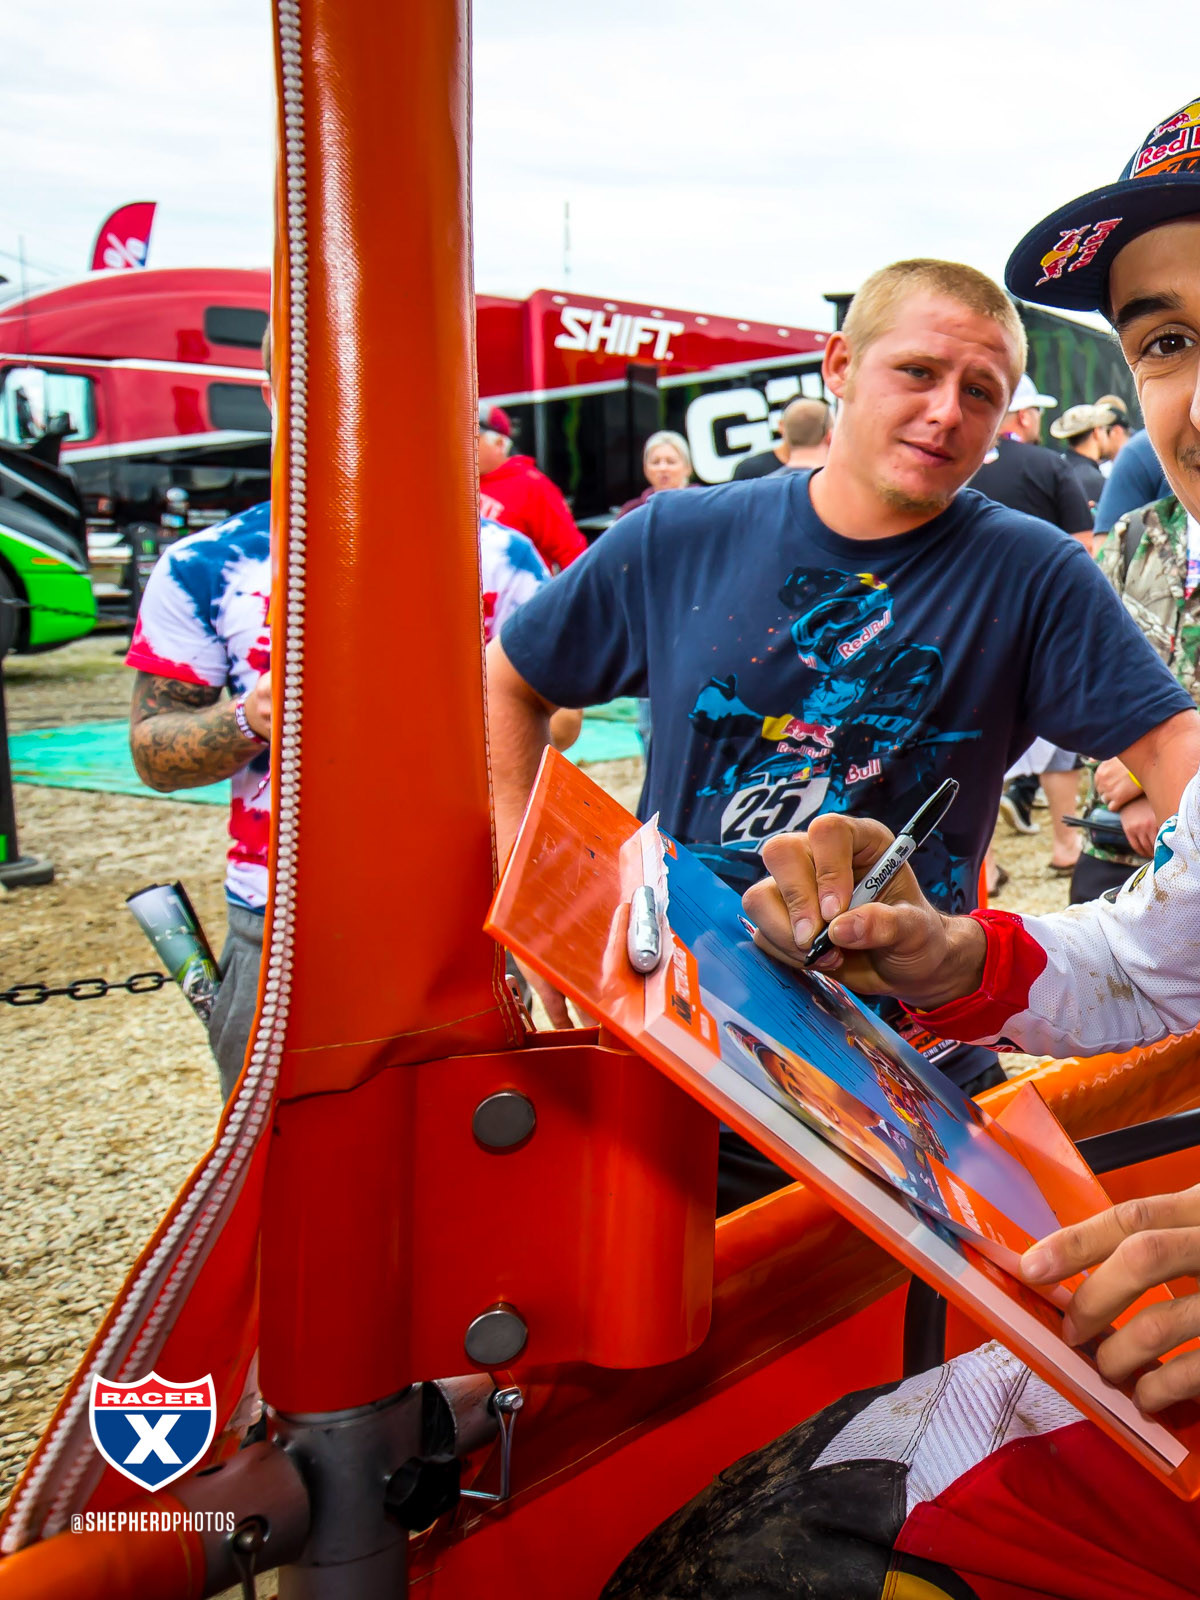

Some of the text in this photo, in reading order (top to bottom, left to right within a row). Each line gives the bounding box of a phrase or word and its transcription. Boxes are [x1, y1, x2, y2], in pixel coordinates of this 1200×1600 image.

[1136, 128, 1189, 172] Red
[554, 306, 685, 361] SHIFT
[837, 609, 892, 660] Red Bull
[845, 758, 882, 785] Bull
[721, 780, 811, 841] 25
[864, 857, 901, 900] Sharpie
[922, 1045, 939, 1058] CING
